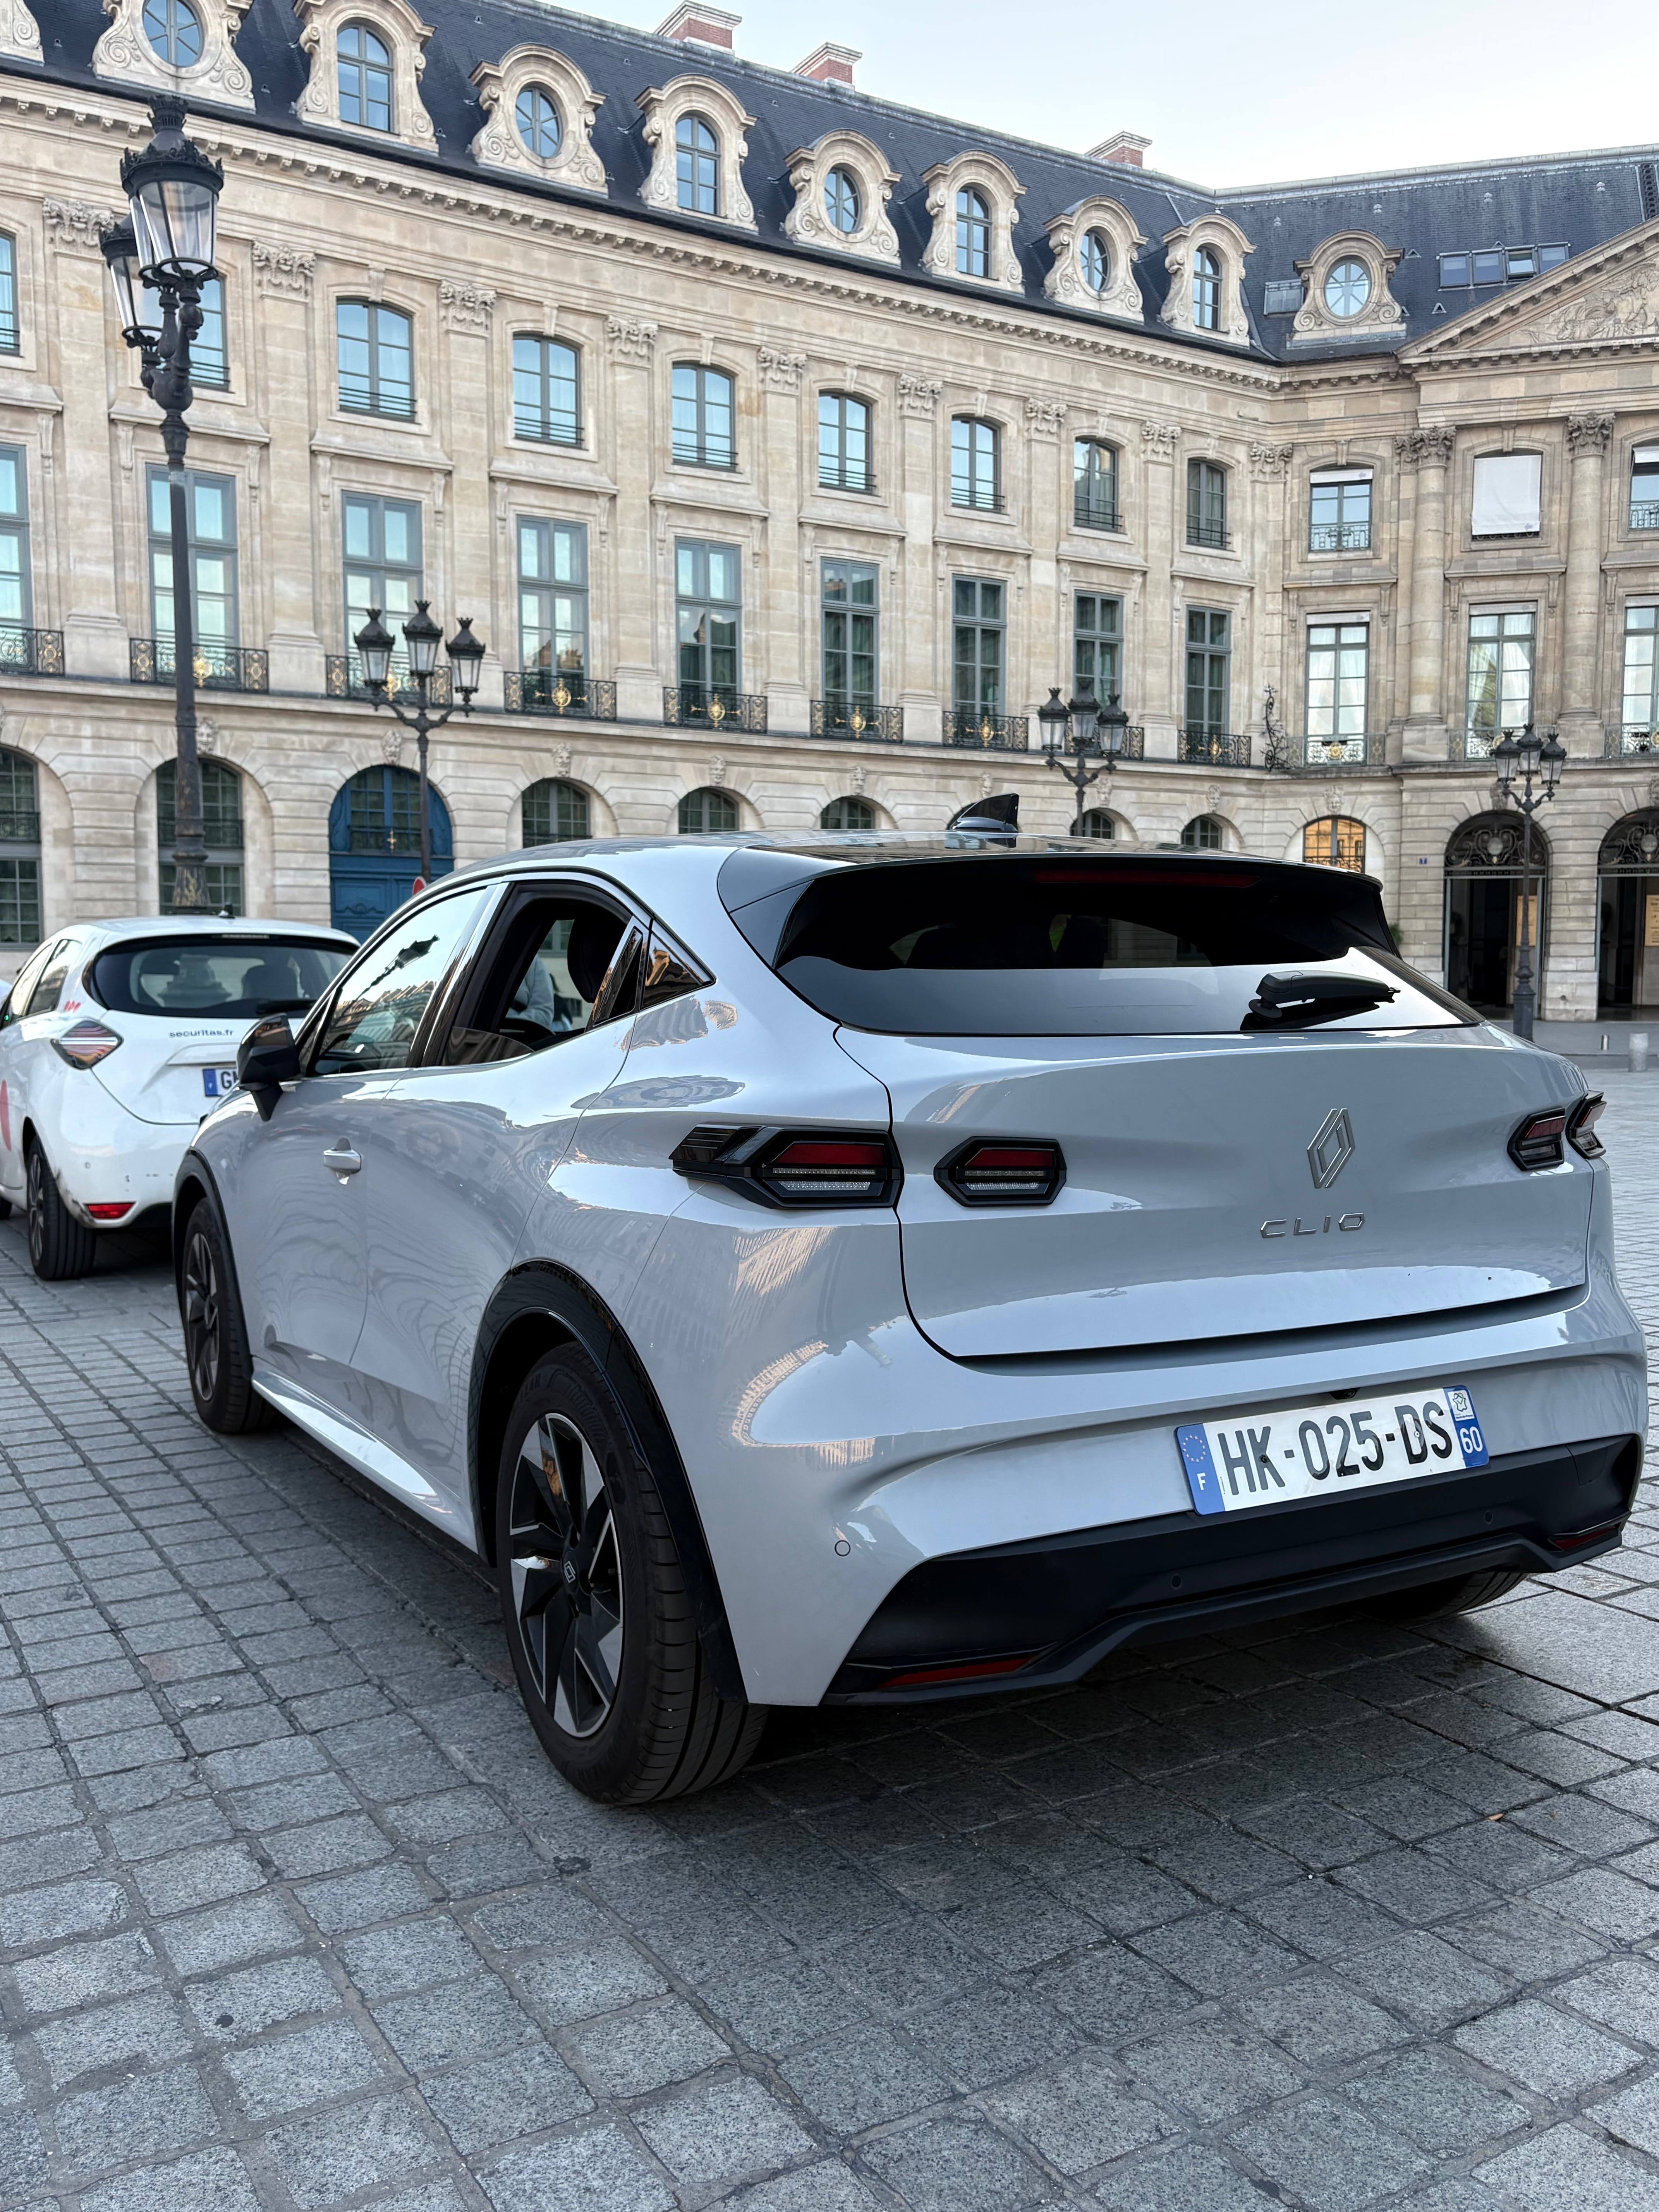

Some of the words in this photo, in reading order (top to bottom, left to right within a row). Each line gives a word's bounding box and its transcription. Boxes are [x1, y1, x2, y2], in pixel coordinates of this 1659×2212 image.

[169, 1029, 233, 1038] securitas.fr
[1261, 1212, 1365, 1238] CLIO
[1218, 1401, 1452, 1495] HK-025-DS
[1460, 1426, 1483, 1453] 60
[1197, 1472, 1206, 1491] F
